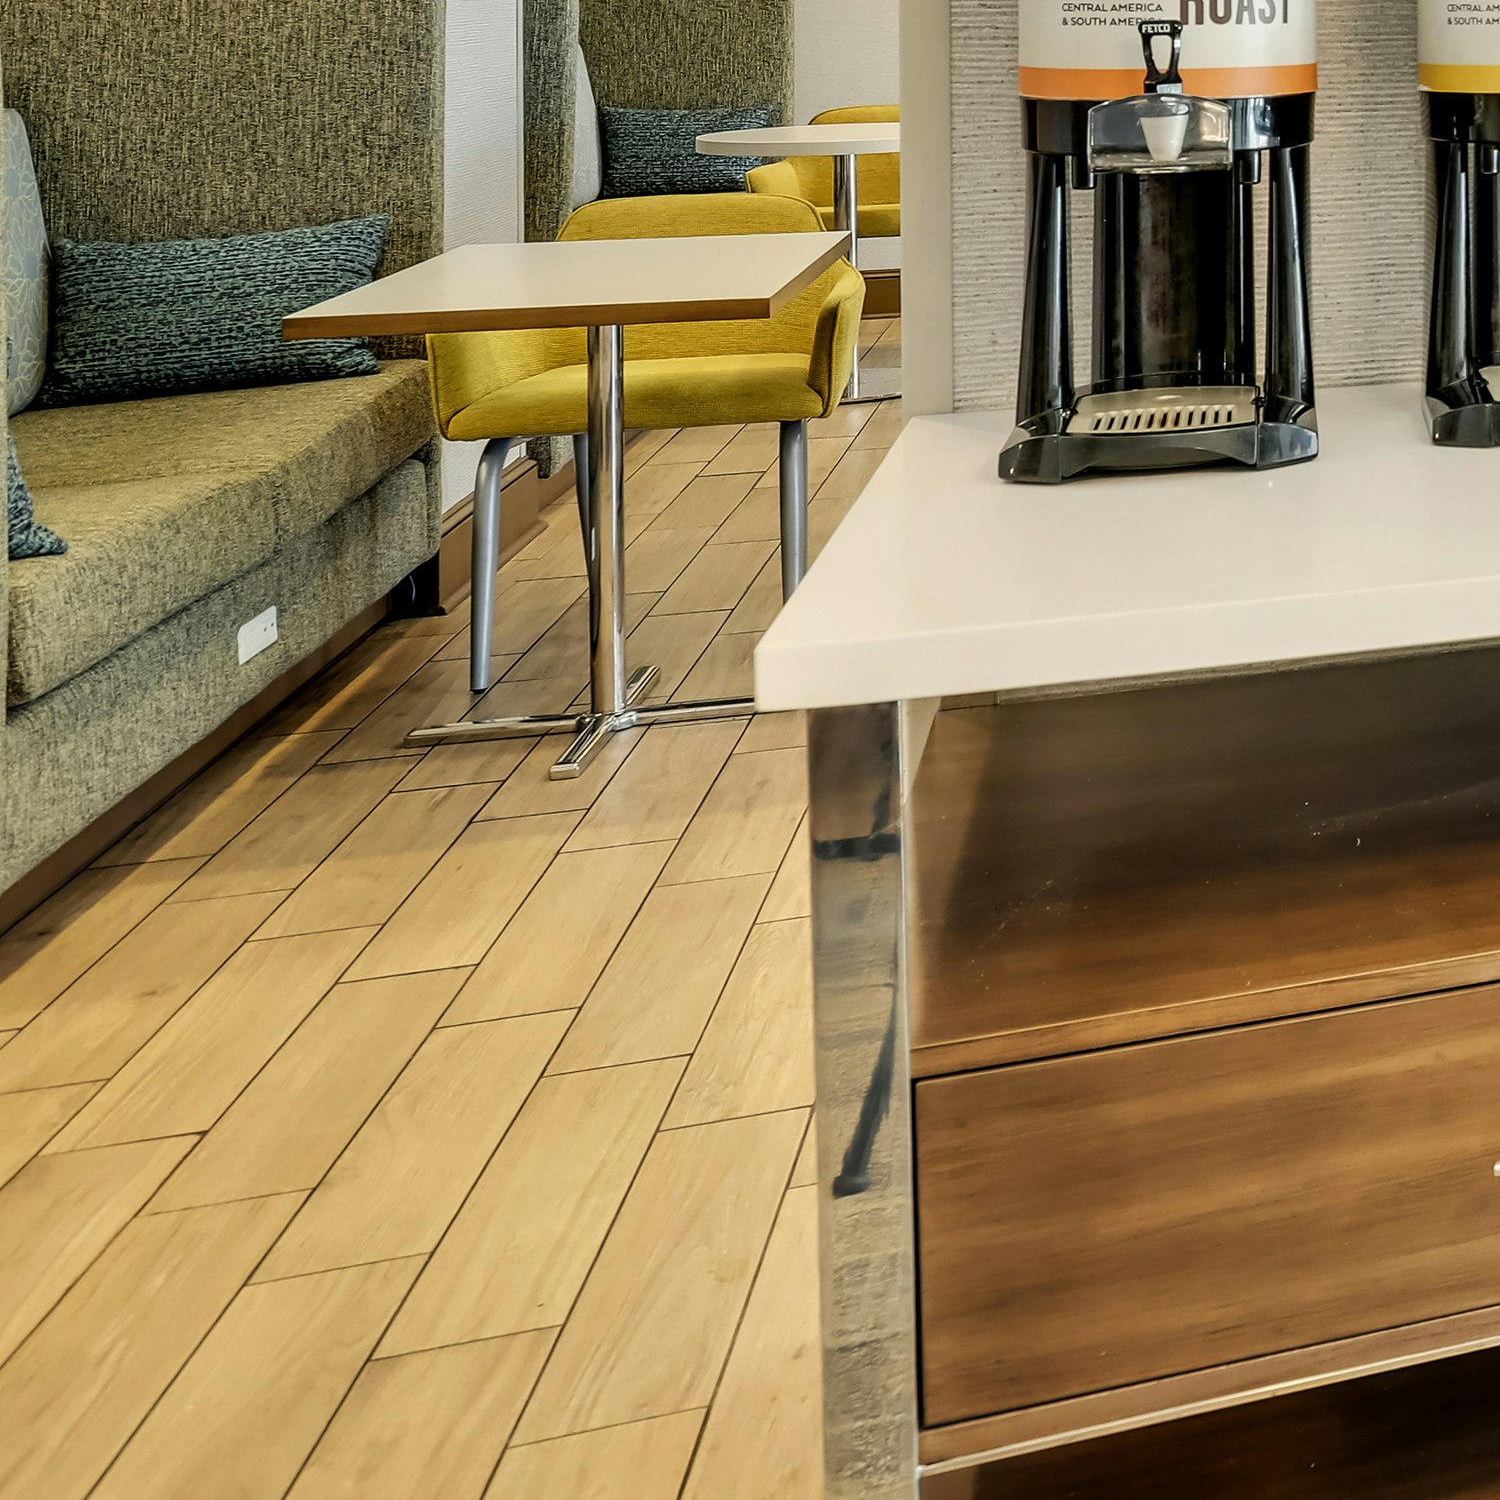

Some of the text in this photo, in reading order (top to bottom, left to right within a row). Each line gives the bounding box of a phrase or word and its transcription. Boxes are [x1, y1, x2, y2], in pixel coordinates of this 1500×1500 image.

[1061, 3, 1164, 12] CENTRAL AMERICA
[1447, 3, 1485, 12] CENTRAL
[1061, 16, 1161, 26] & SOUTH AMER
[1453, 16, 1483, 25] SOUTH
[1141, 23, 1171, 34] FETCO
